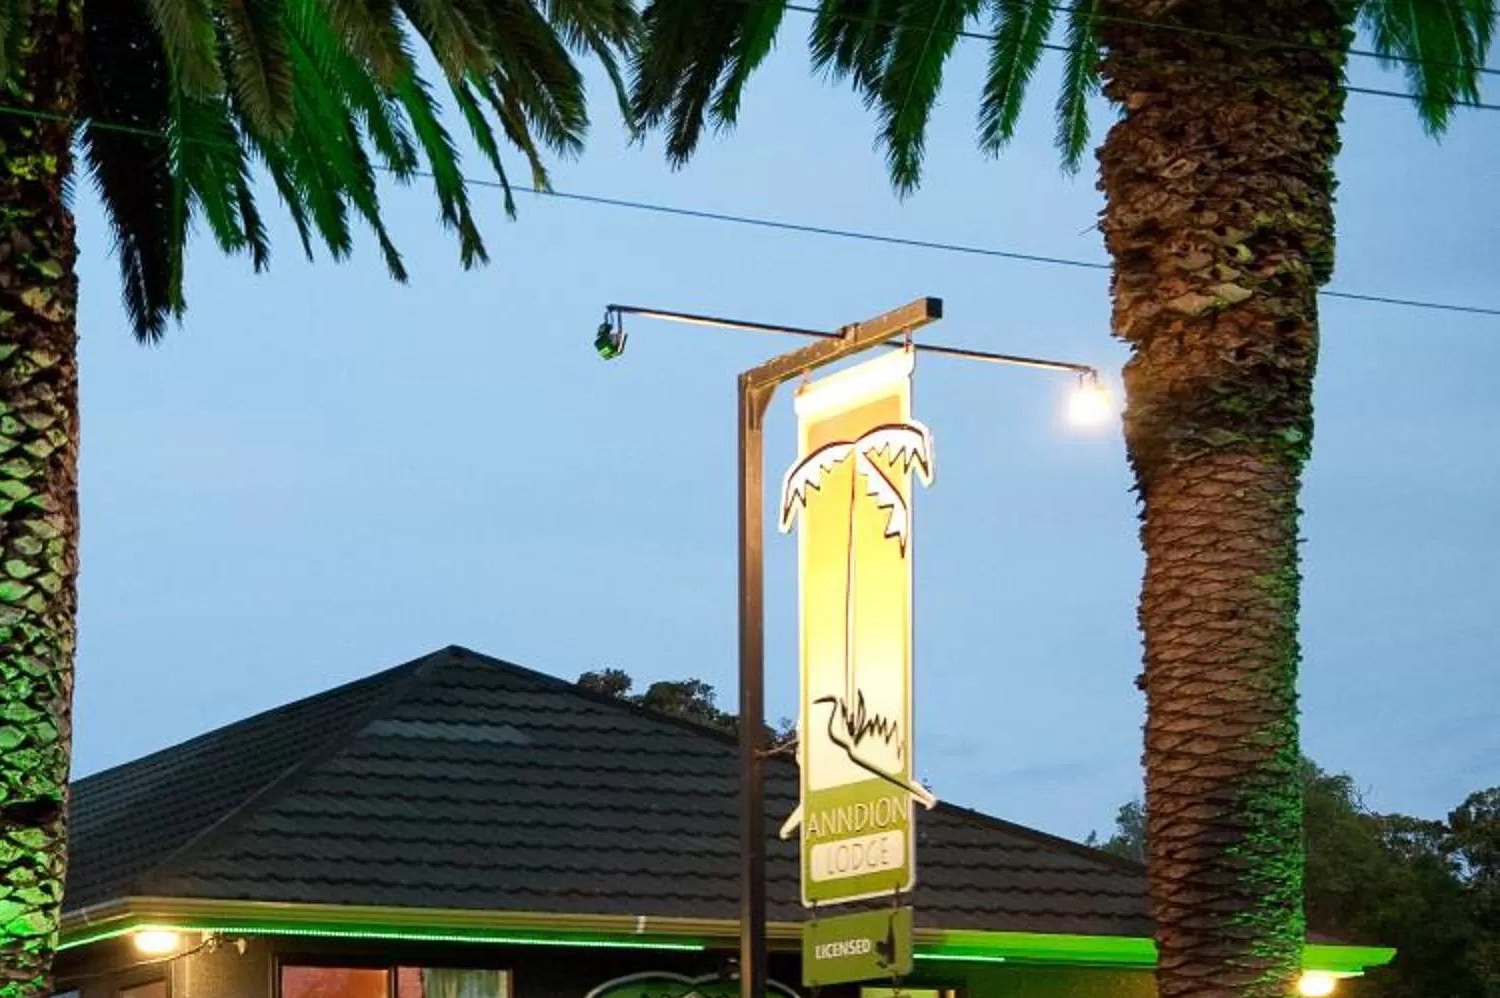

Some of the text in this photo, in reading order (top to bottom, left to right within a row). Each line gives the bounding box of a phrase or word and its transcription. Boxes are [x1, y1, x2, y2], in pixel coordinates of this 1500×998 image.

[805, 795, 907, 839] ANNDION
[826, 836, 890, 876] LODGE
[815, 938, 871, 960] LICENSED
